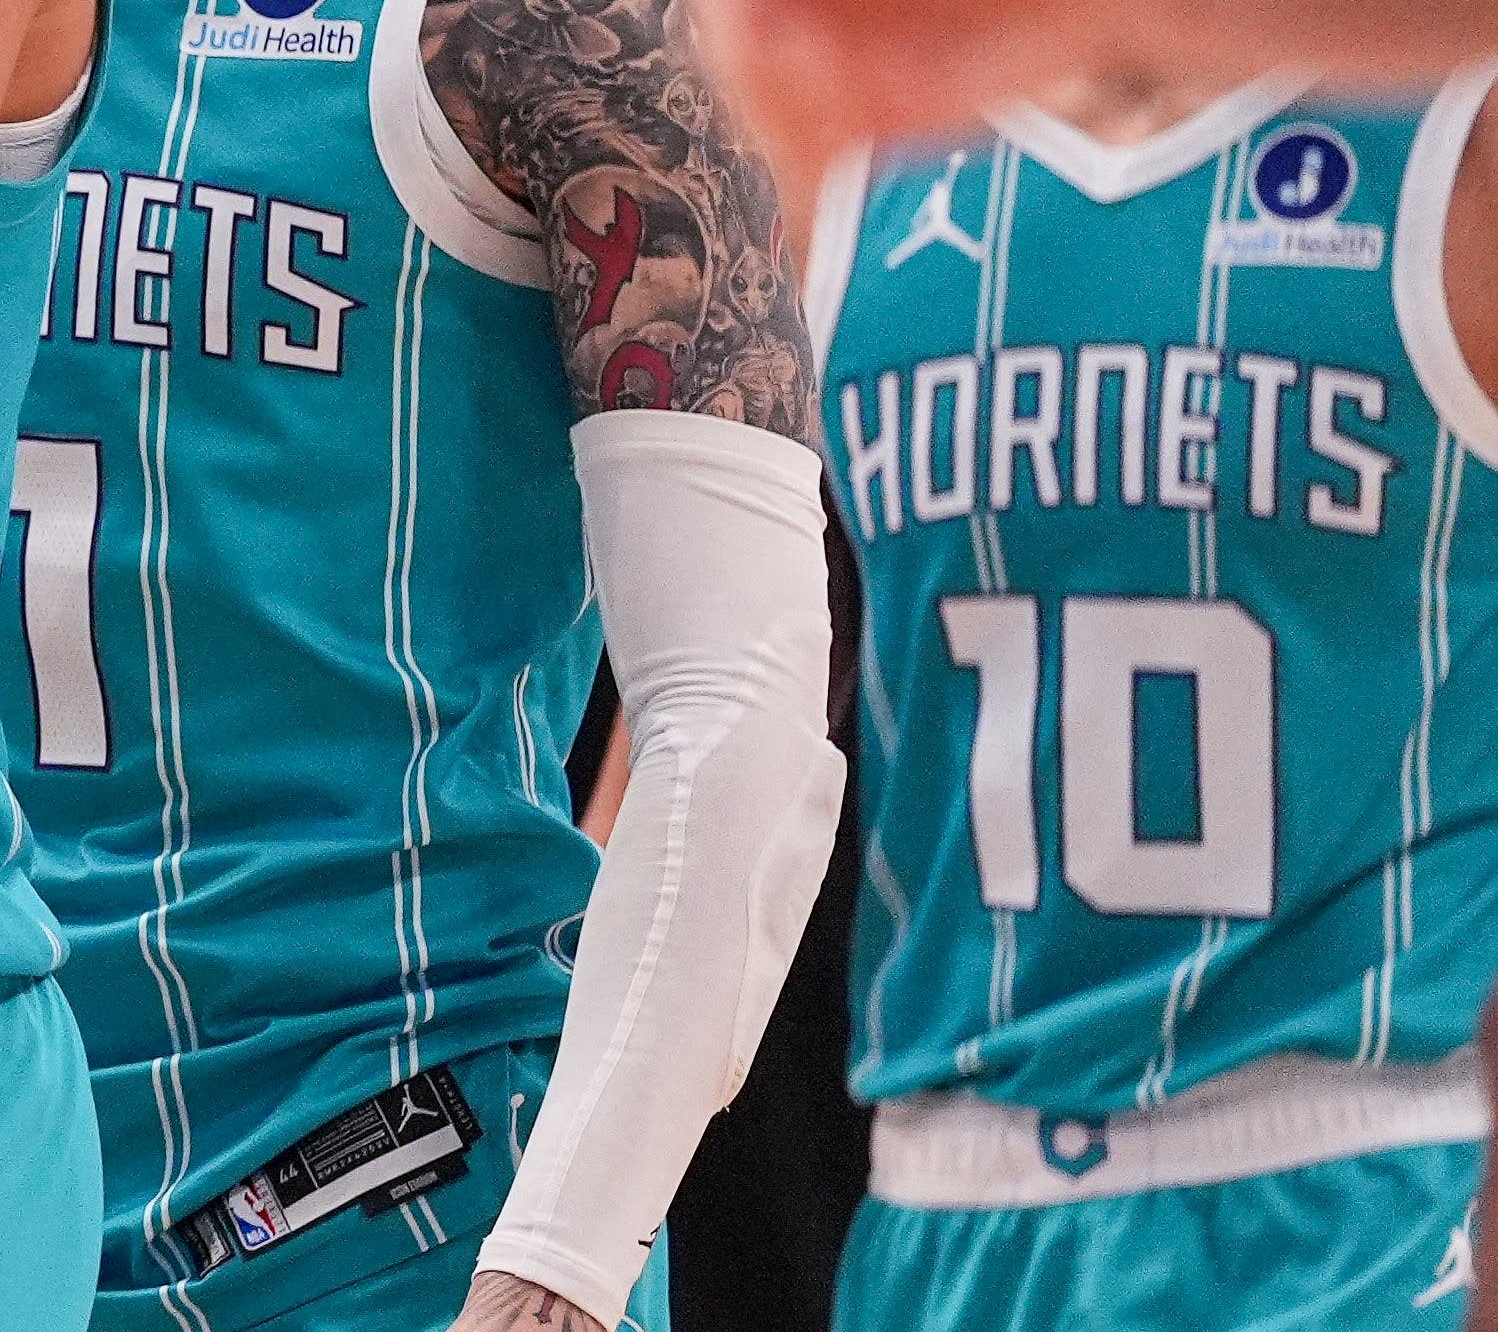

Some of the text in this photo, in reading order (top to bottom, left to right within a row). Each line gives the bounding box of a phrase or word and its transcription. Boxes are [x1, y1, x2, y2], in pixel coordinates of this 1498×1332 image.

[189, 21, 354, 55] Judi Health
[39, 168, 367, 376] NETS
[838, 342, 1400, 542] HORNETS
[937, 591, 1279, 921] 10
